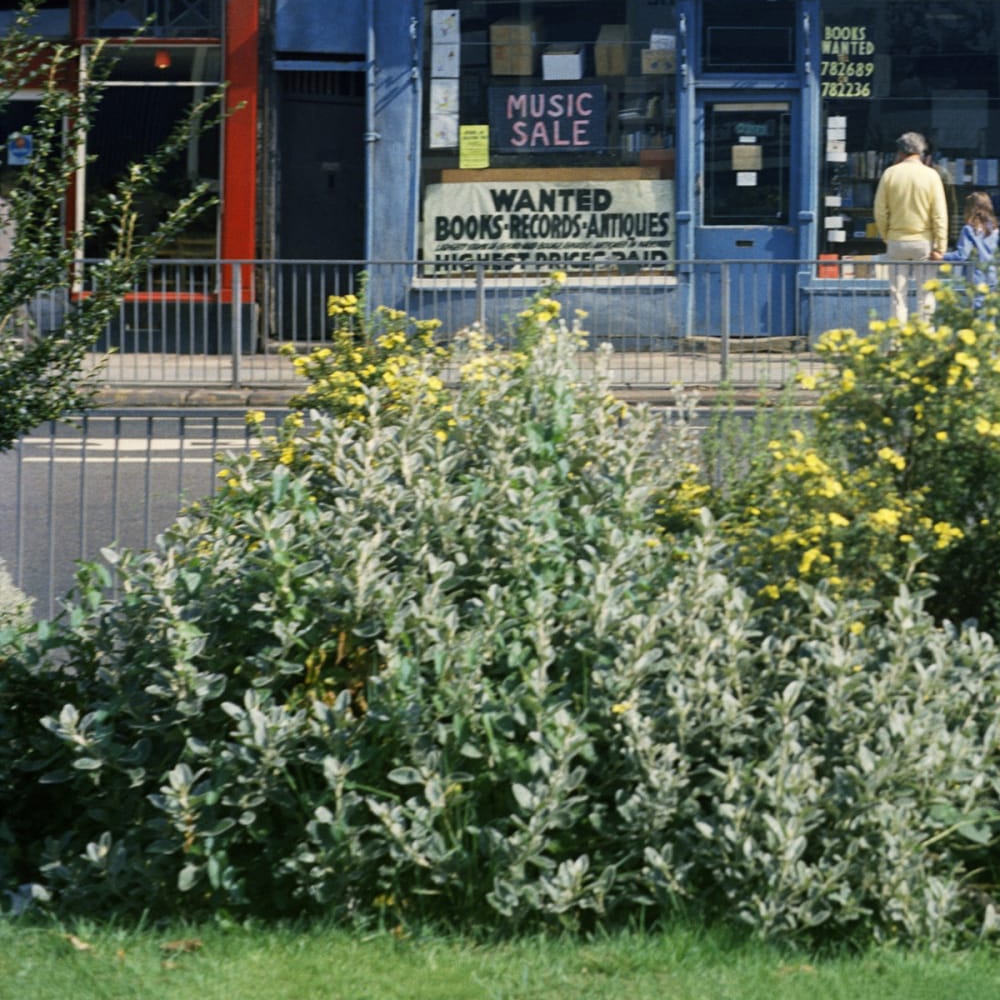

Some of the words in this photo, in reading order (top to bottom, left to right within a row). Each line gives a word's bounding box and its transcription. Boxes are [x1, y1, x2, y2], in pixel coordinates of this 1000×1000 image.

[824, 26, 866, 40] BOOKS
[821, 40, 875, 55] WANTED
[821, 61, 874, 77] 782689
[821, 82, 871, 97] 782236
[507, 92, 593, 120] MUSIC
[510, 119, 590, 147] SALE
[490, 189, 612, 212] WANTED
[435, 252, 529, 271] HIGHEST
